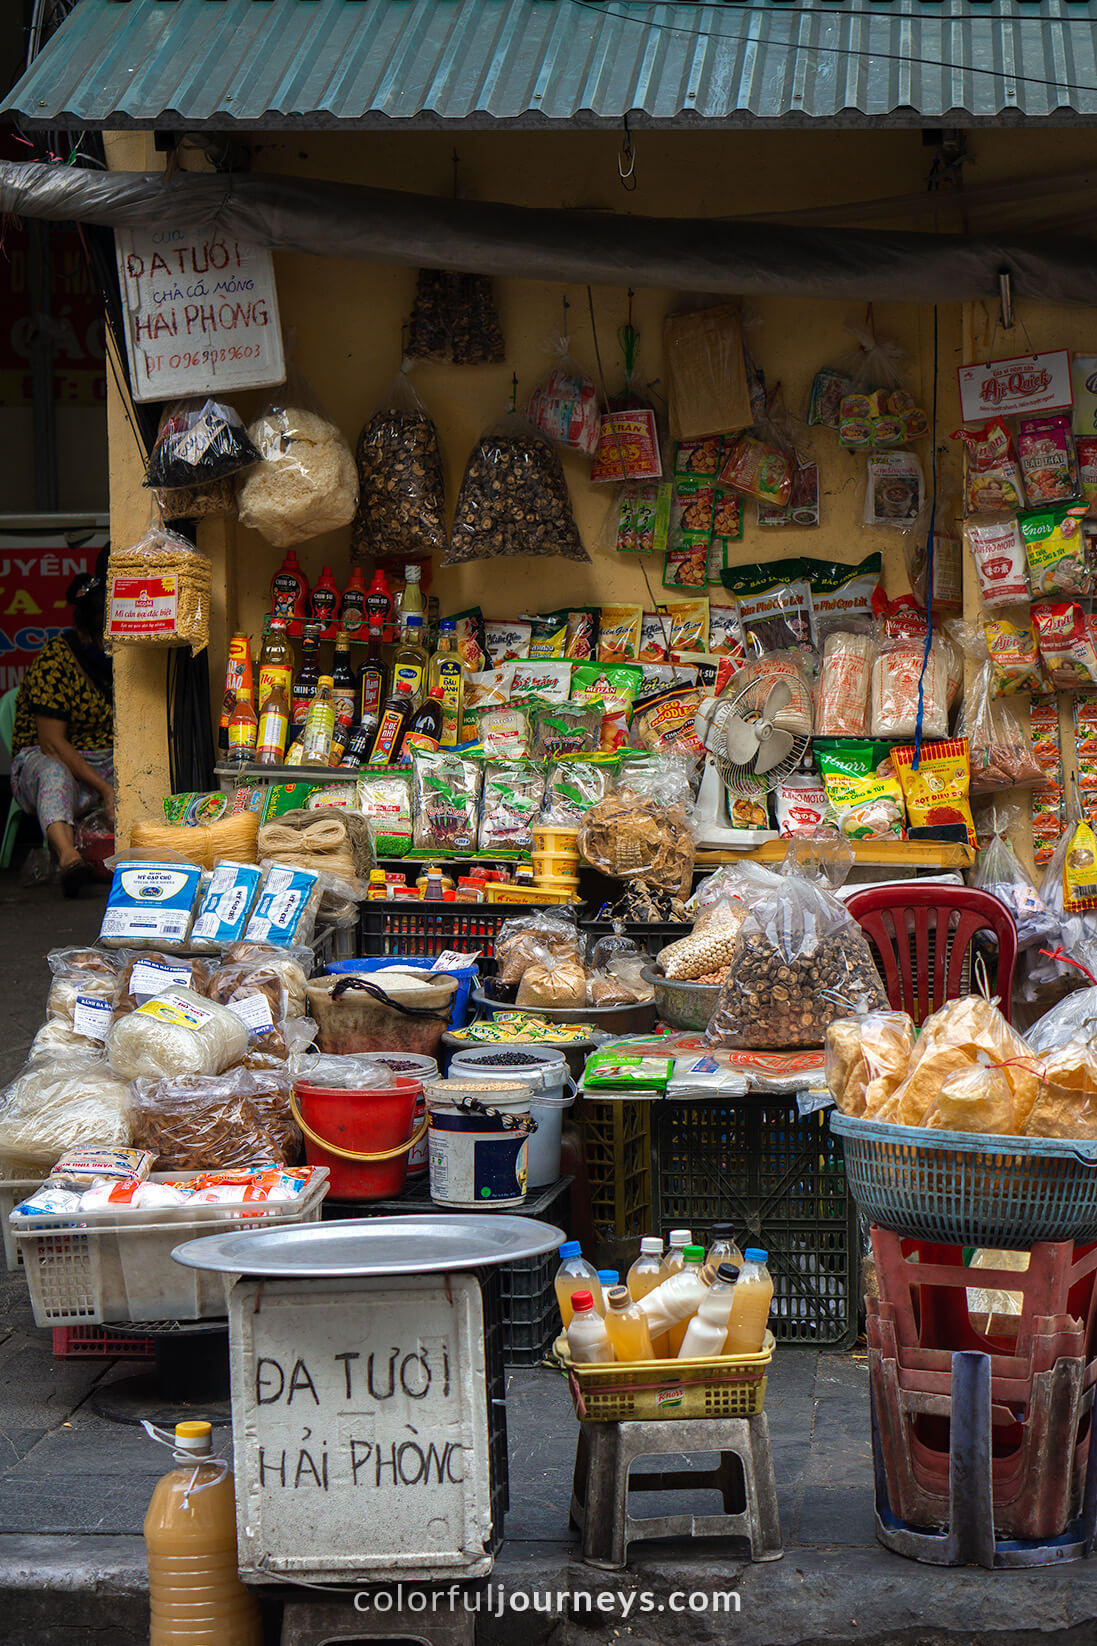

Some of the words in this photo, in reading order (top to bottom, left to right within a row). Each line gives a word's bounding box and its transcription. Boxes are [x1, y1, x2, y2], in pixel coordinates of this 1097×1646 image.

[1021, 524, 1053, 537] Knorr
[822, 755, 869, 772] Knorr
[256, 1357, 320, 1406] ĐA
[334, 1345, 450, 1400] TƯƠI
[657, 1389, 685, 1402] Knorr
[258, 1426, 329, 1492] HẢI
